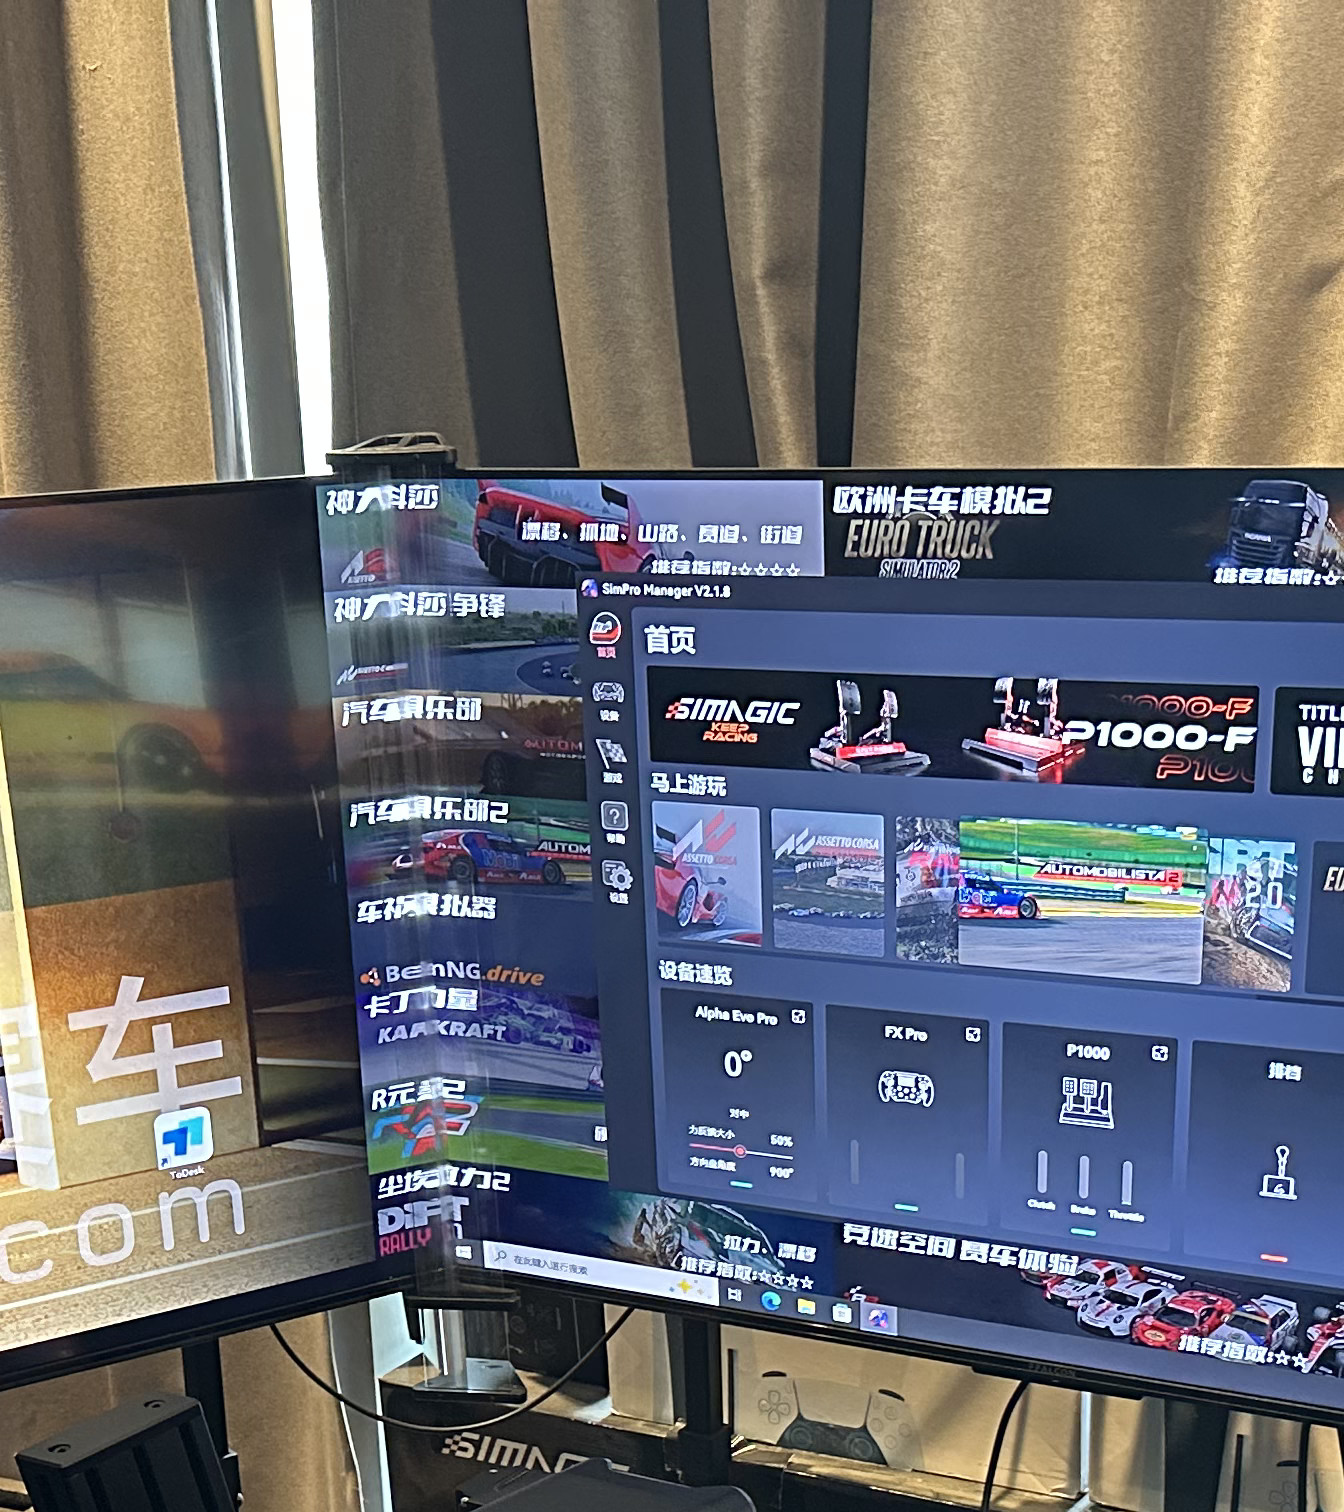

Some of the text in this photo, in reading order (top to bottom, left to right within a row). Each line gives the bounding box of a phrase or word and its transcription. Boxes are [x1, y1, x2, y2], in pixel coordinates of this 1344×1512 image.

[833, 486, 1053, 515] 欧洲卡车模拟2
[844, 519, 1000, 560] EURO TRUCK
[602, 583, 642, 597] SimPro
[643, 584, 693, 600] Manager
[643, 625, 697, 655] 首页
[668, 697, 801, 725] SIMAGIC
[702, 731, 759, 744] RACING
[711, 722, 751, 733] KEEP
[1062, 720, 1258, 752] P1000-F
[651, 772, 727, 797] 马上游玩
[682, 852, 714, 865] ASSETTO
[1040, 862, 1165, 882] AUTOMOBILISTA
[1245, 882, 1284, 910] 2.0
[659, 960, 733, 987] 设备速览
[695, 1005, 779, 1026] Alpha Evo Pro
[884, 1025, 928, 1042] FX Pro
[1066, 1043, 1111, 1061] P1000
[169, 1167, 205, 1181] ToDesk
[379, 1226, 433, 1257] RALLY
